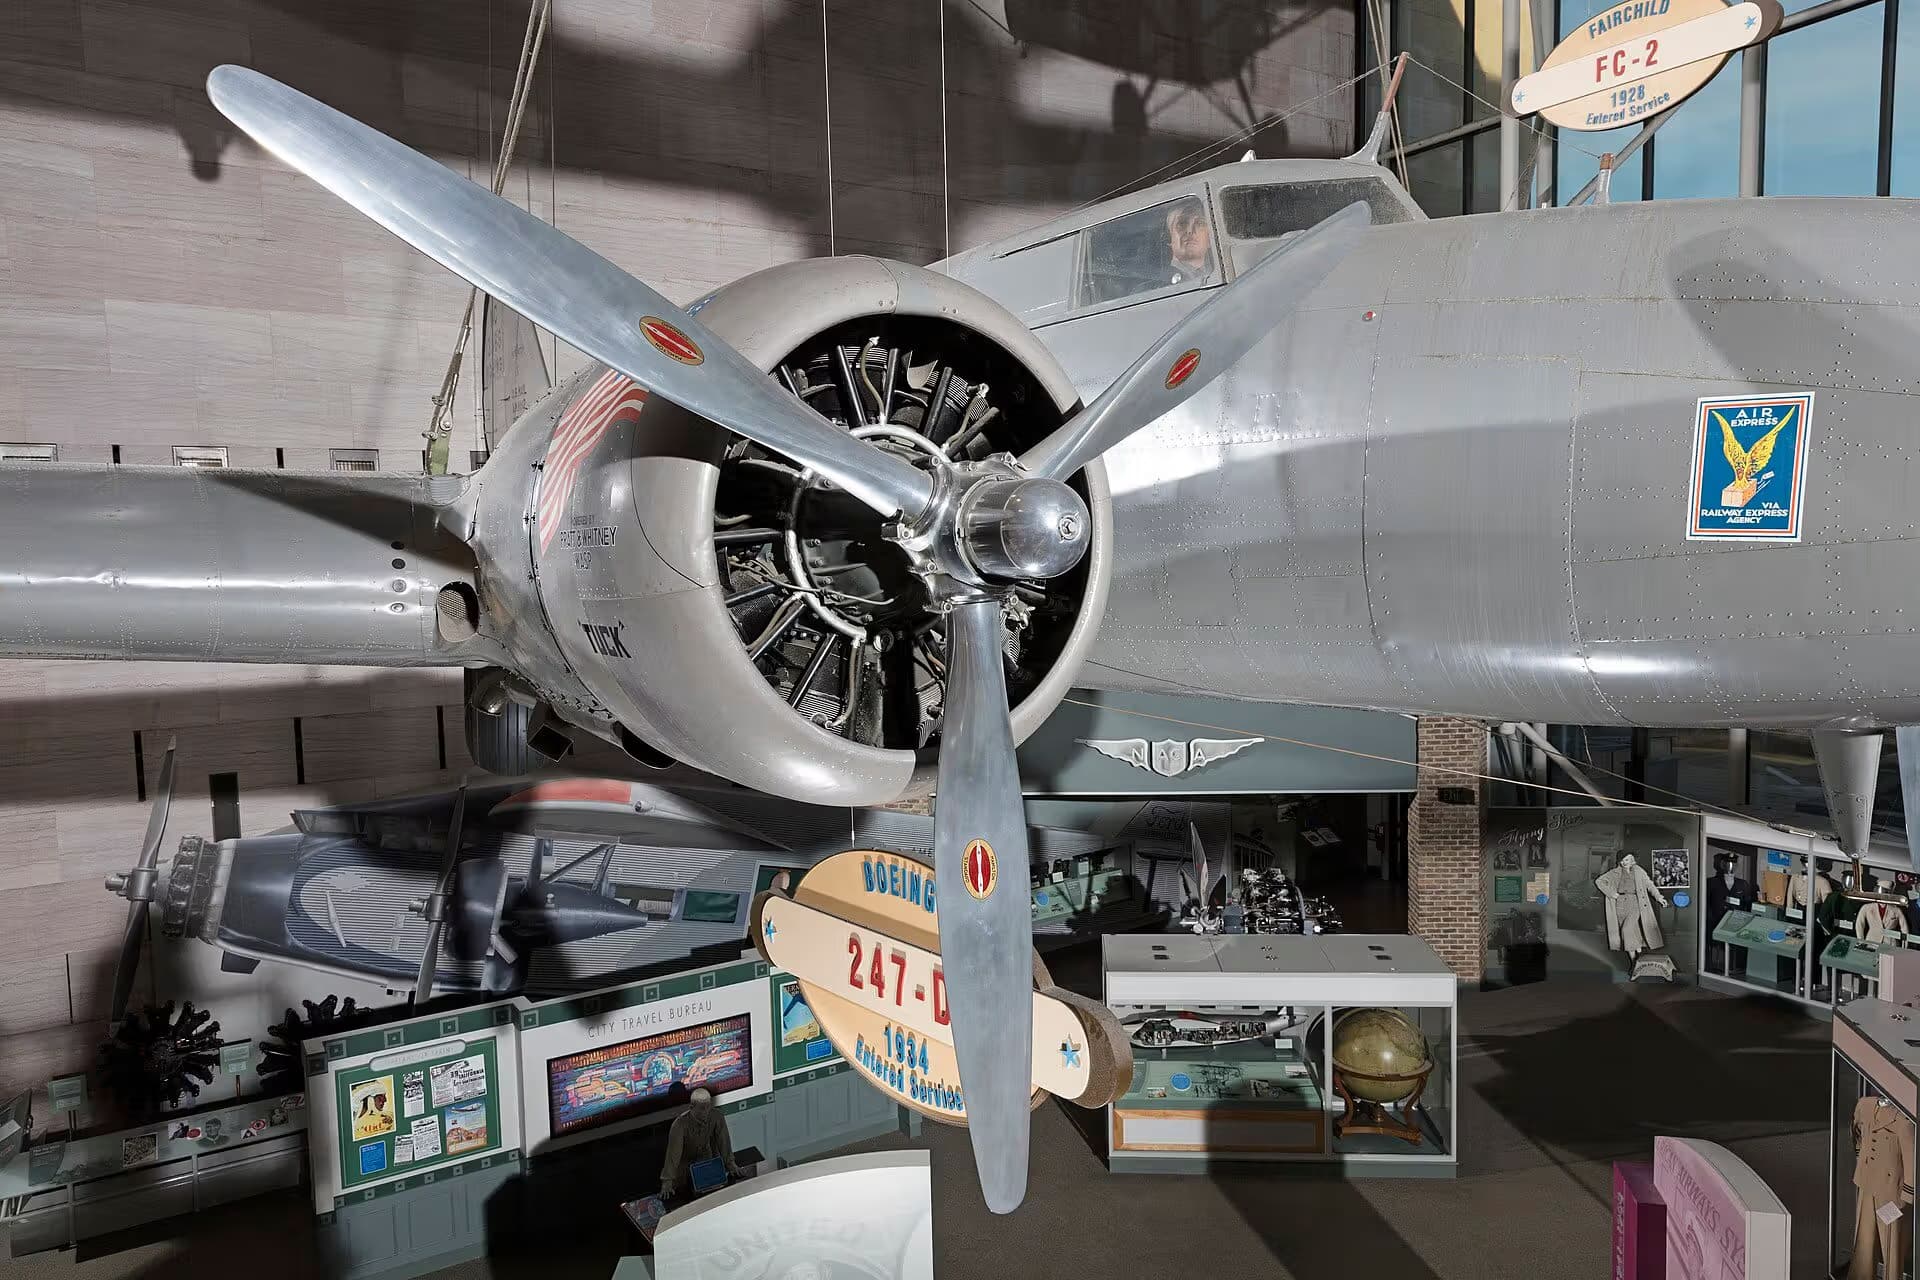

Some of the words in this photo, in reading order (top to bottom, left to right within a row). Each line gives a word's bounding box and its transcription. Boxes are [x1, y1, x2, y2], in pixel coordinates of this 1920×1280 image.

[1588, 0, 1671, 39] FAIRCHILD
[1595, 39, 1660, 83] FC-2
[1585, 105, 1626, 126] Entered
[1629, 91, 1671, 118] Service
[1610, 84, 1646, 108] 1928
[1730, 417, 1779, 427] EXPRESS
[1735, 407, 1773, 419] AIR
[1701, 508, 1743, 517] RAILWAY
[1745, 508, 1789, 517] EXPRESS
[1726, 516, 1763, 524] AGENCY
[1761, 502, 1780, 510] VIA
[863, 856, 936, 914] BOEING
[847, 932, 950, 1026] 247-D
[587, 1021, 616, 1039] CITY
[622, 1012, 663, 1030] TRAVEL
[669, 999, 713, 1020] BUREAU
[883, 1021, 930, 1075] 1934
[855, 1033, 905, 1093] Entered
[909, 1070, 965, 1112] Service
